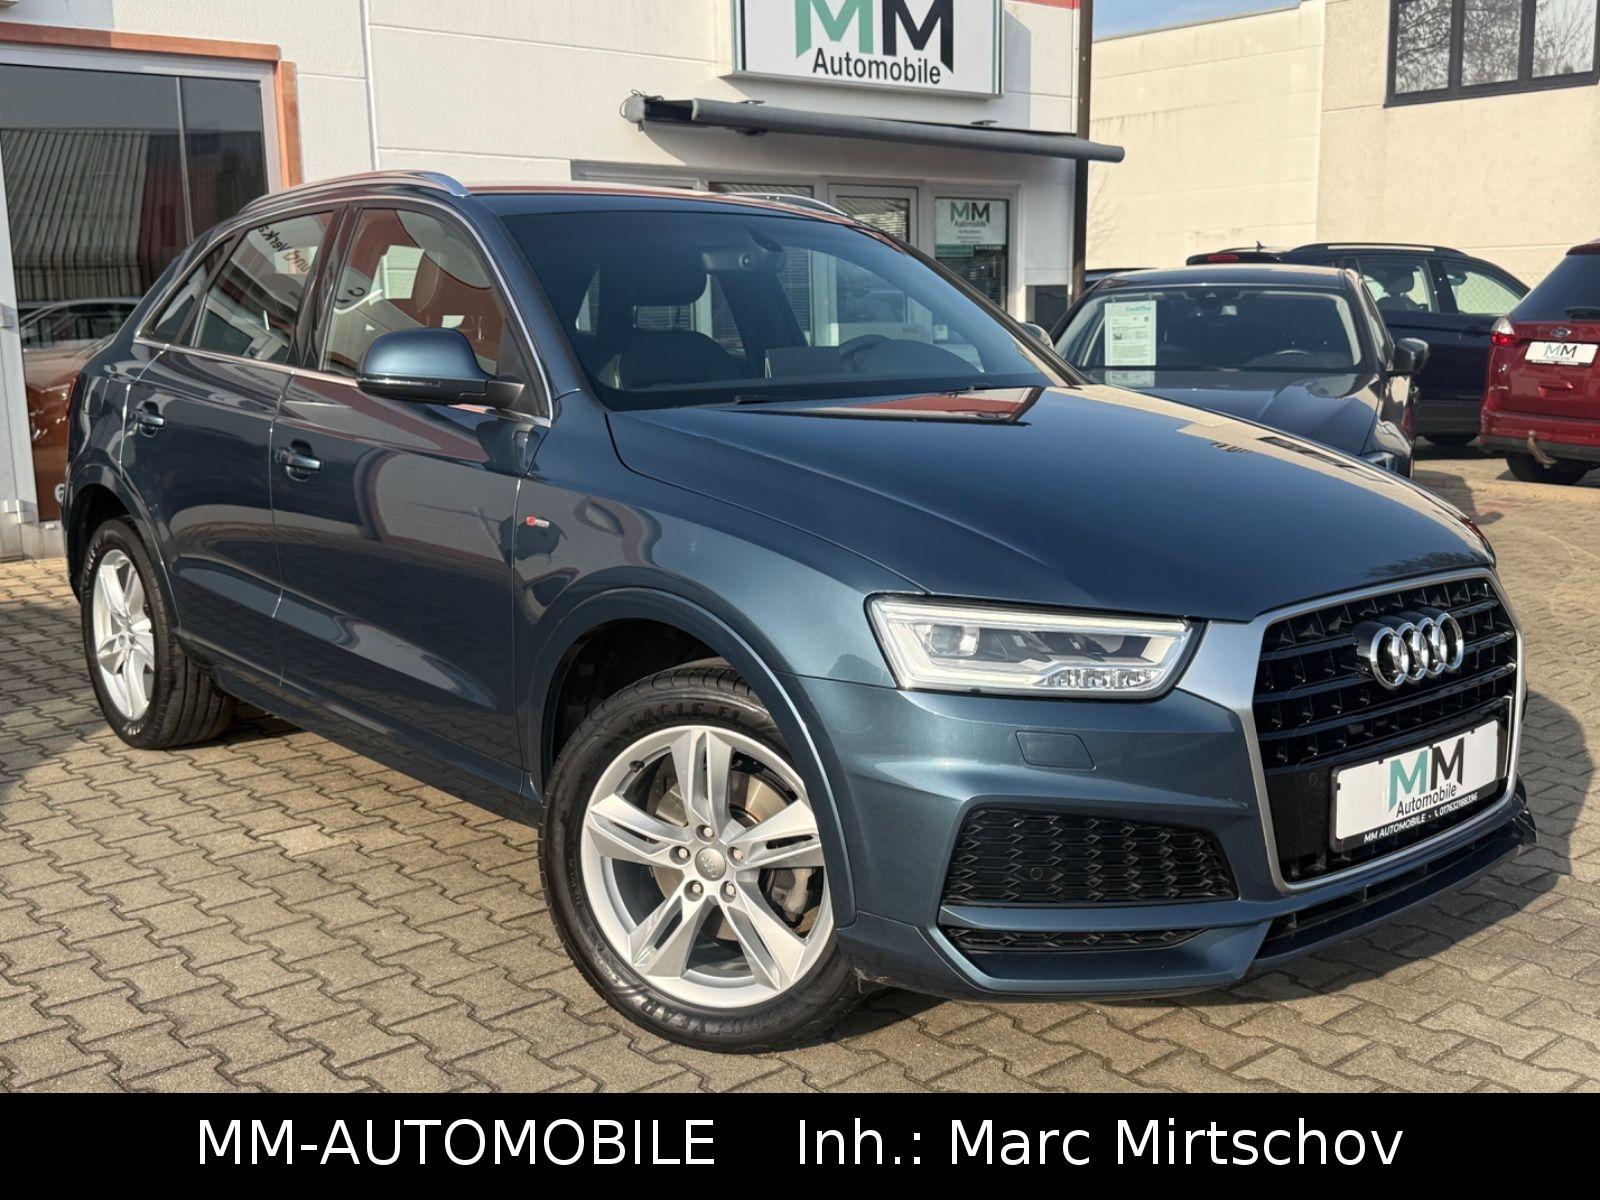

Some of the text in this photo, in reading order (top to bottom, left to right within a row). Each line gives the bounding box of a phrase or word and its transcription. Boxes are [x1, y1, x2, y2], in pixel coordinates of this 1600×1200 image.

[795, 0, 954, 73] MM
[812, 47, 941, 85] Automobile
[950, 201, 990, 224] MM
[1543, 343, 1577, 358] MM
[1388, 737, 1464, 814] MM
[1395, 784, 1457, 818] Automobile
[1363, 813, 1427, 843] MM AUTOMOBILE
